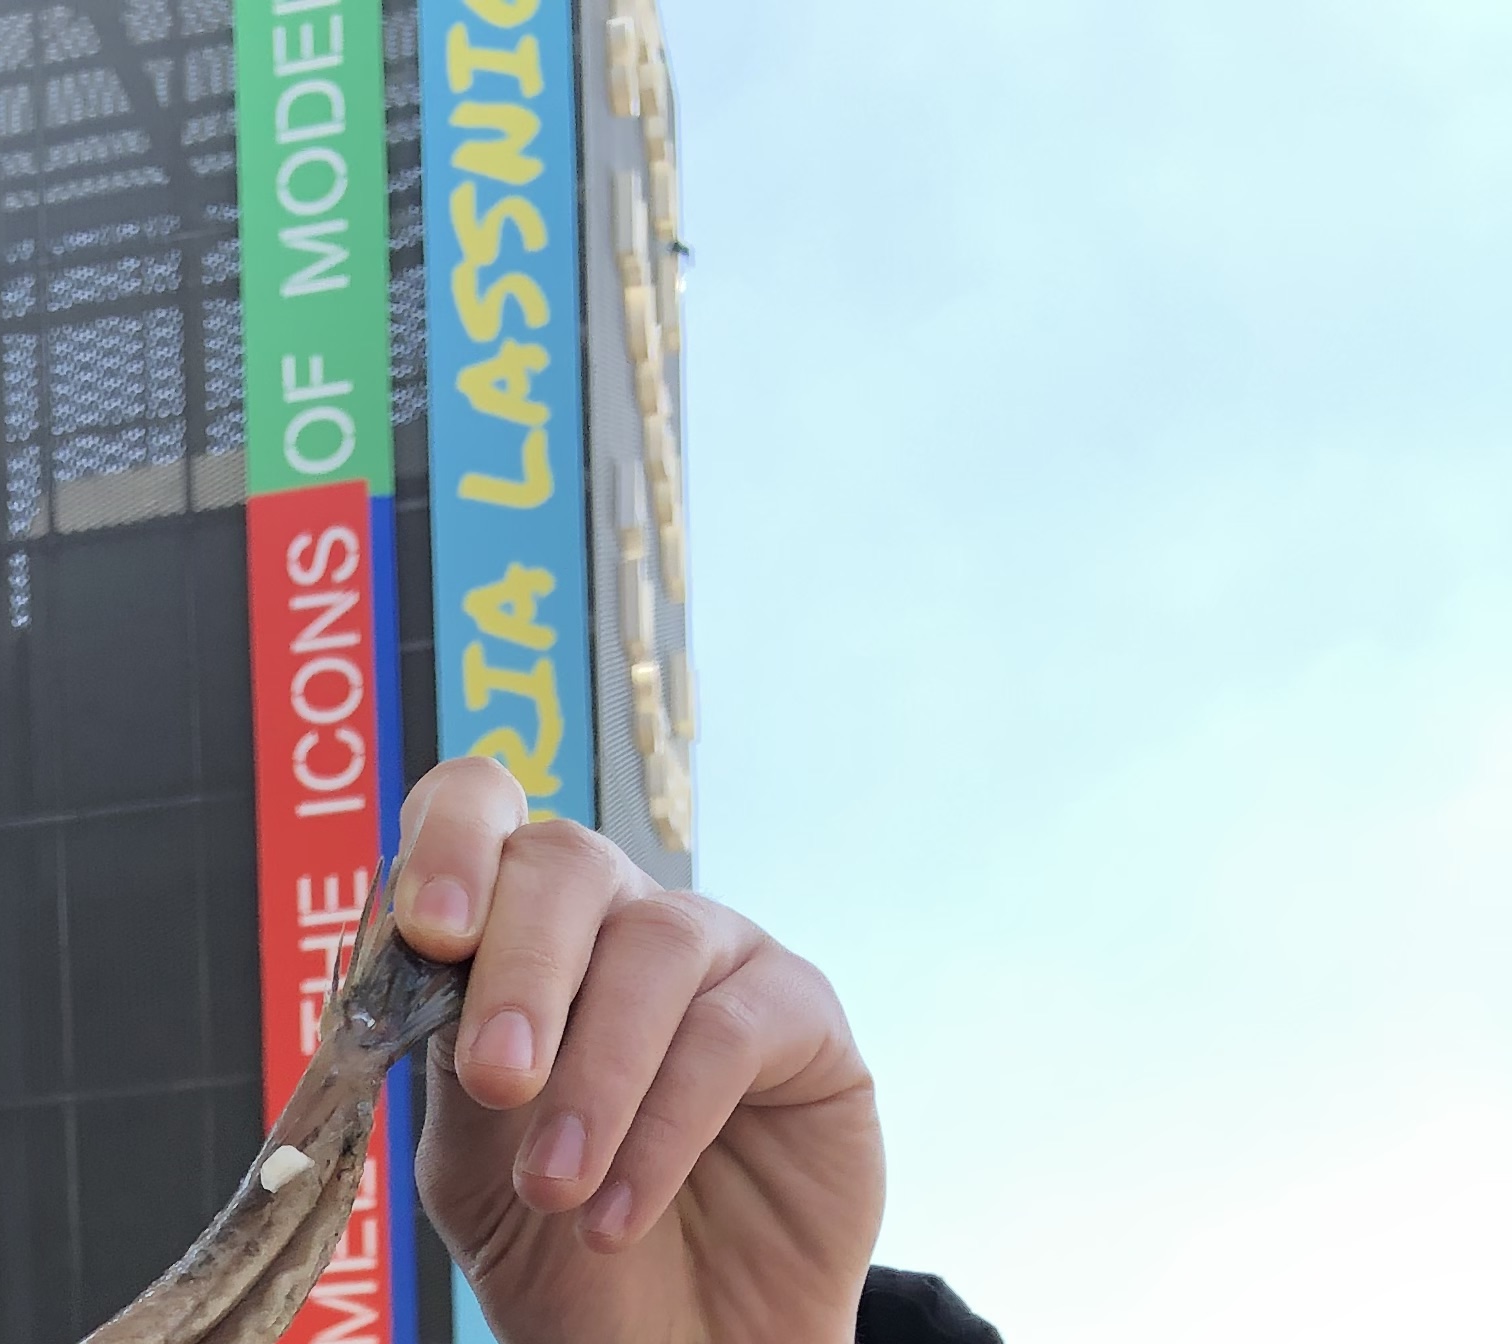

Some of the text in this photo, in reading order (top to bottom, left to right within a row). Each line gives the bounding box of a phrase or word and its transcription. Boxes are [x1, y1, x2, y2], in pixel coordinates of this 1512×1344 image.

[272, 0, 352, 298] MODE
[281, 354, 356, 475] OF
[288, 524, 366, 817] ICONS
[462, 562, 565, 824] RIA
